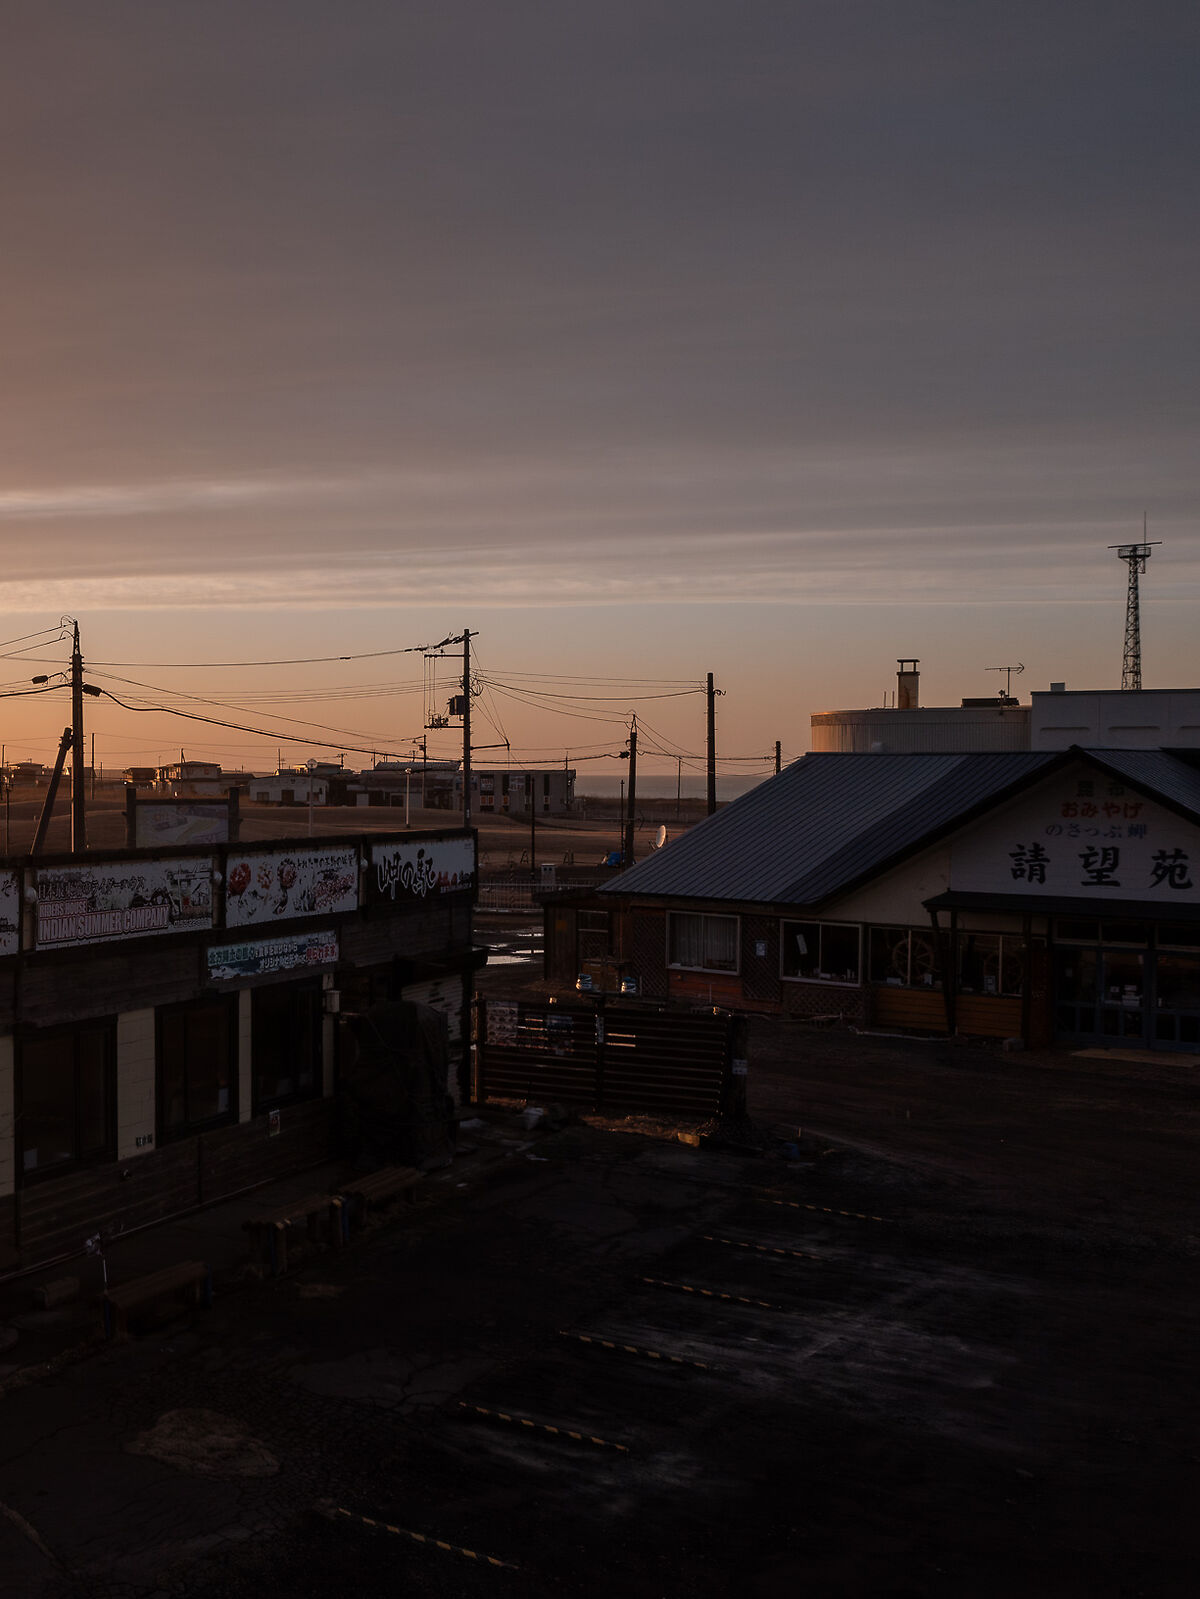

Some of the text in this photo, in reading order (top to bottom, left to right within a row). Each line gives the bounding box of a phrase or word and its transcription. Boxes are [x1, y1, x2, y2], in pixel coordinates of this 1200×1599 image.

[1061, 801, 1144, 818] おみやげ
[1009, 842, 1193, 889] 請望苑
[39, 914, 76, 942] INDIAN
[77, 911, 122, 937] SUMMER
[124, 904, 169, 931] COMPANY
